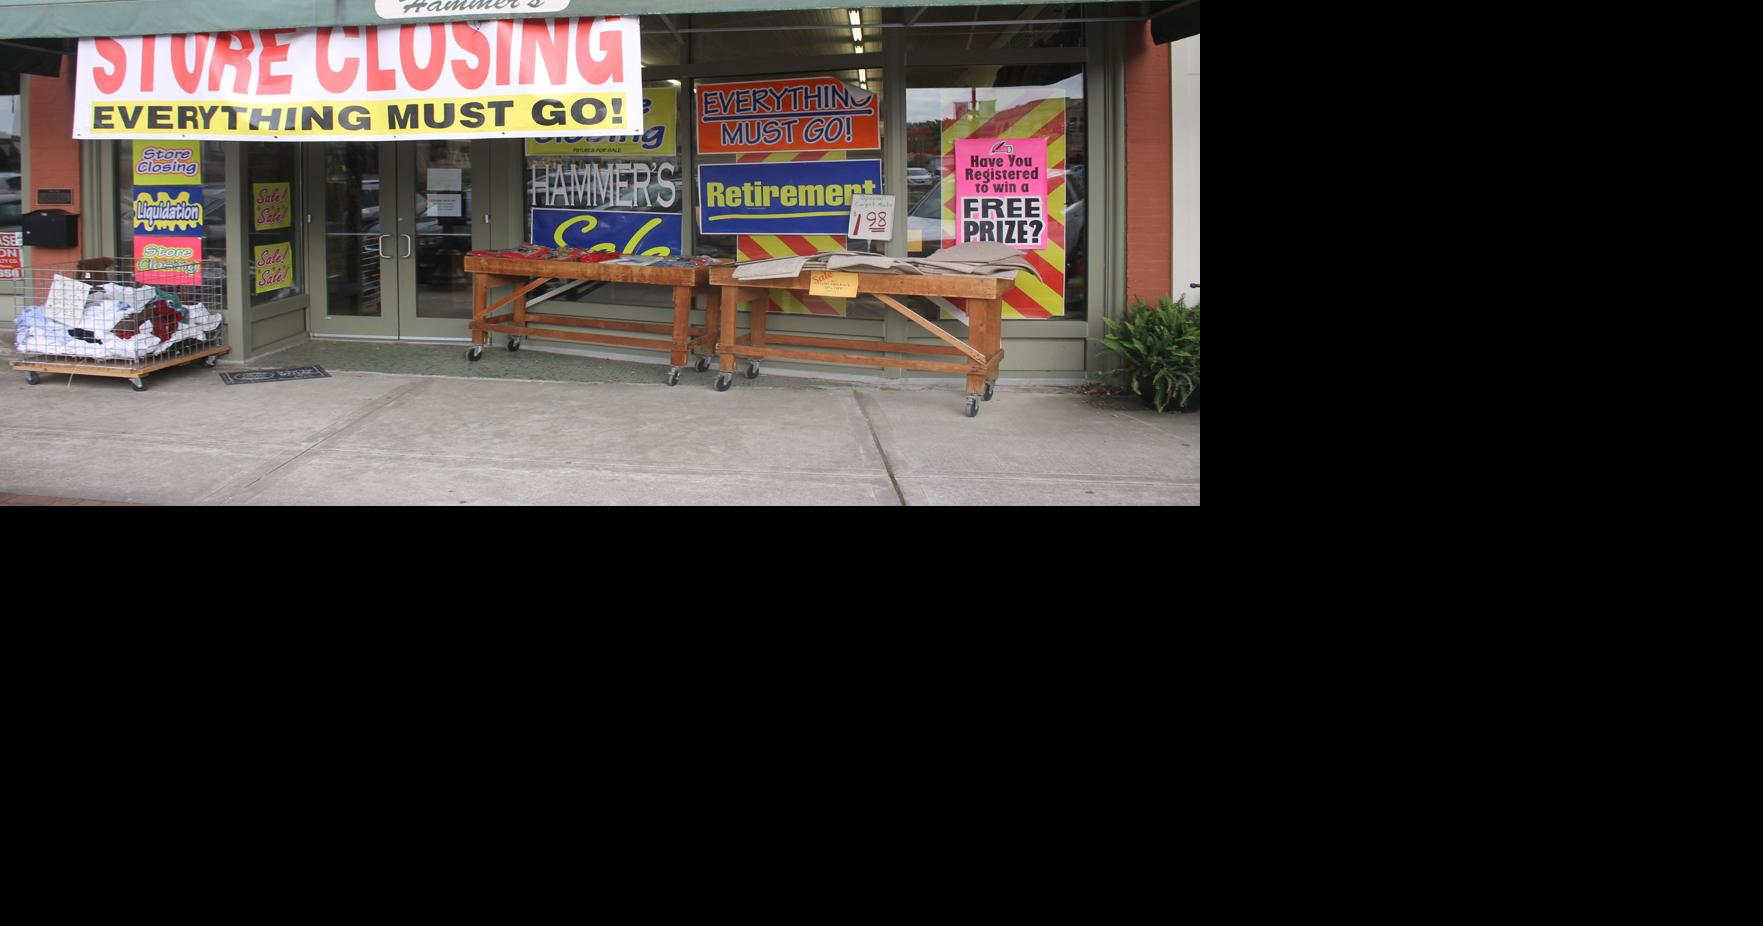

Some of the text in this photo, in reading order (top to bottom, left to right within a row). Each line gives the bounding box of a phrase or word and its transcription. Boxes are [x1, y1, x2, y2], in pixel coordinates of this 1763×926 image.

[403, 0, 544, 13] Hammers
[92, 16, 624, 95] STORE CLOSING
[93, 104, 371, 131] EVERYTHING
[387, 100, 514, 130] MUST
[531, 97, 623, 127] GO!
[721, 116, 853, 146] MUST GO!
[142, 148, 192, 161] Store
[970, 155, 1033, 168] Have You
[136, 161, 197, 175] Closing
[965, 167, 1039, 183] Registered
[532, 162, 676, 208] HAMMER'S
[707, 180, 876, 208] Retirement
[975, 182, 1030, 193] to win a
[256, 188, 288, 204] Sale!
[137, 201, 199, 225] Liquidation
[257, 207, 288, 224] Sale!
[963, 197, 1041, 219] FREE
[554, 215, 671, 258] Sl
[963, 220, 1044, 244] PRIZE?
[143, 245, 193, 258] Store
[257, 247, 289, 267] Sale!
[137, 258, 198, 275] Closing
[258, 267, 289, 287] Sale!
